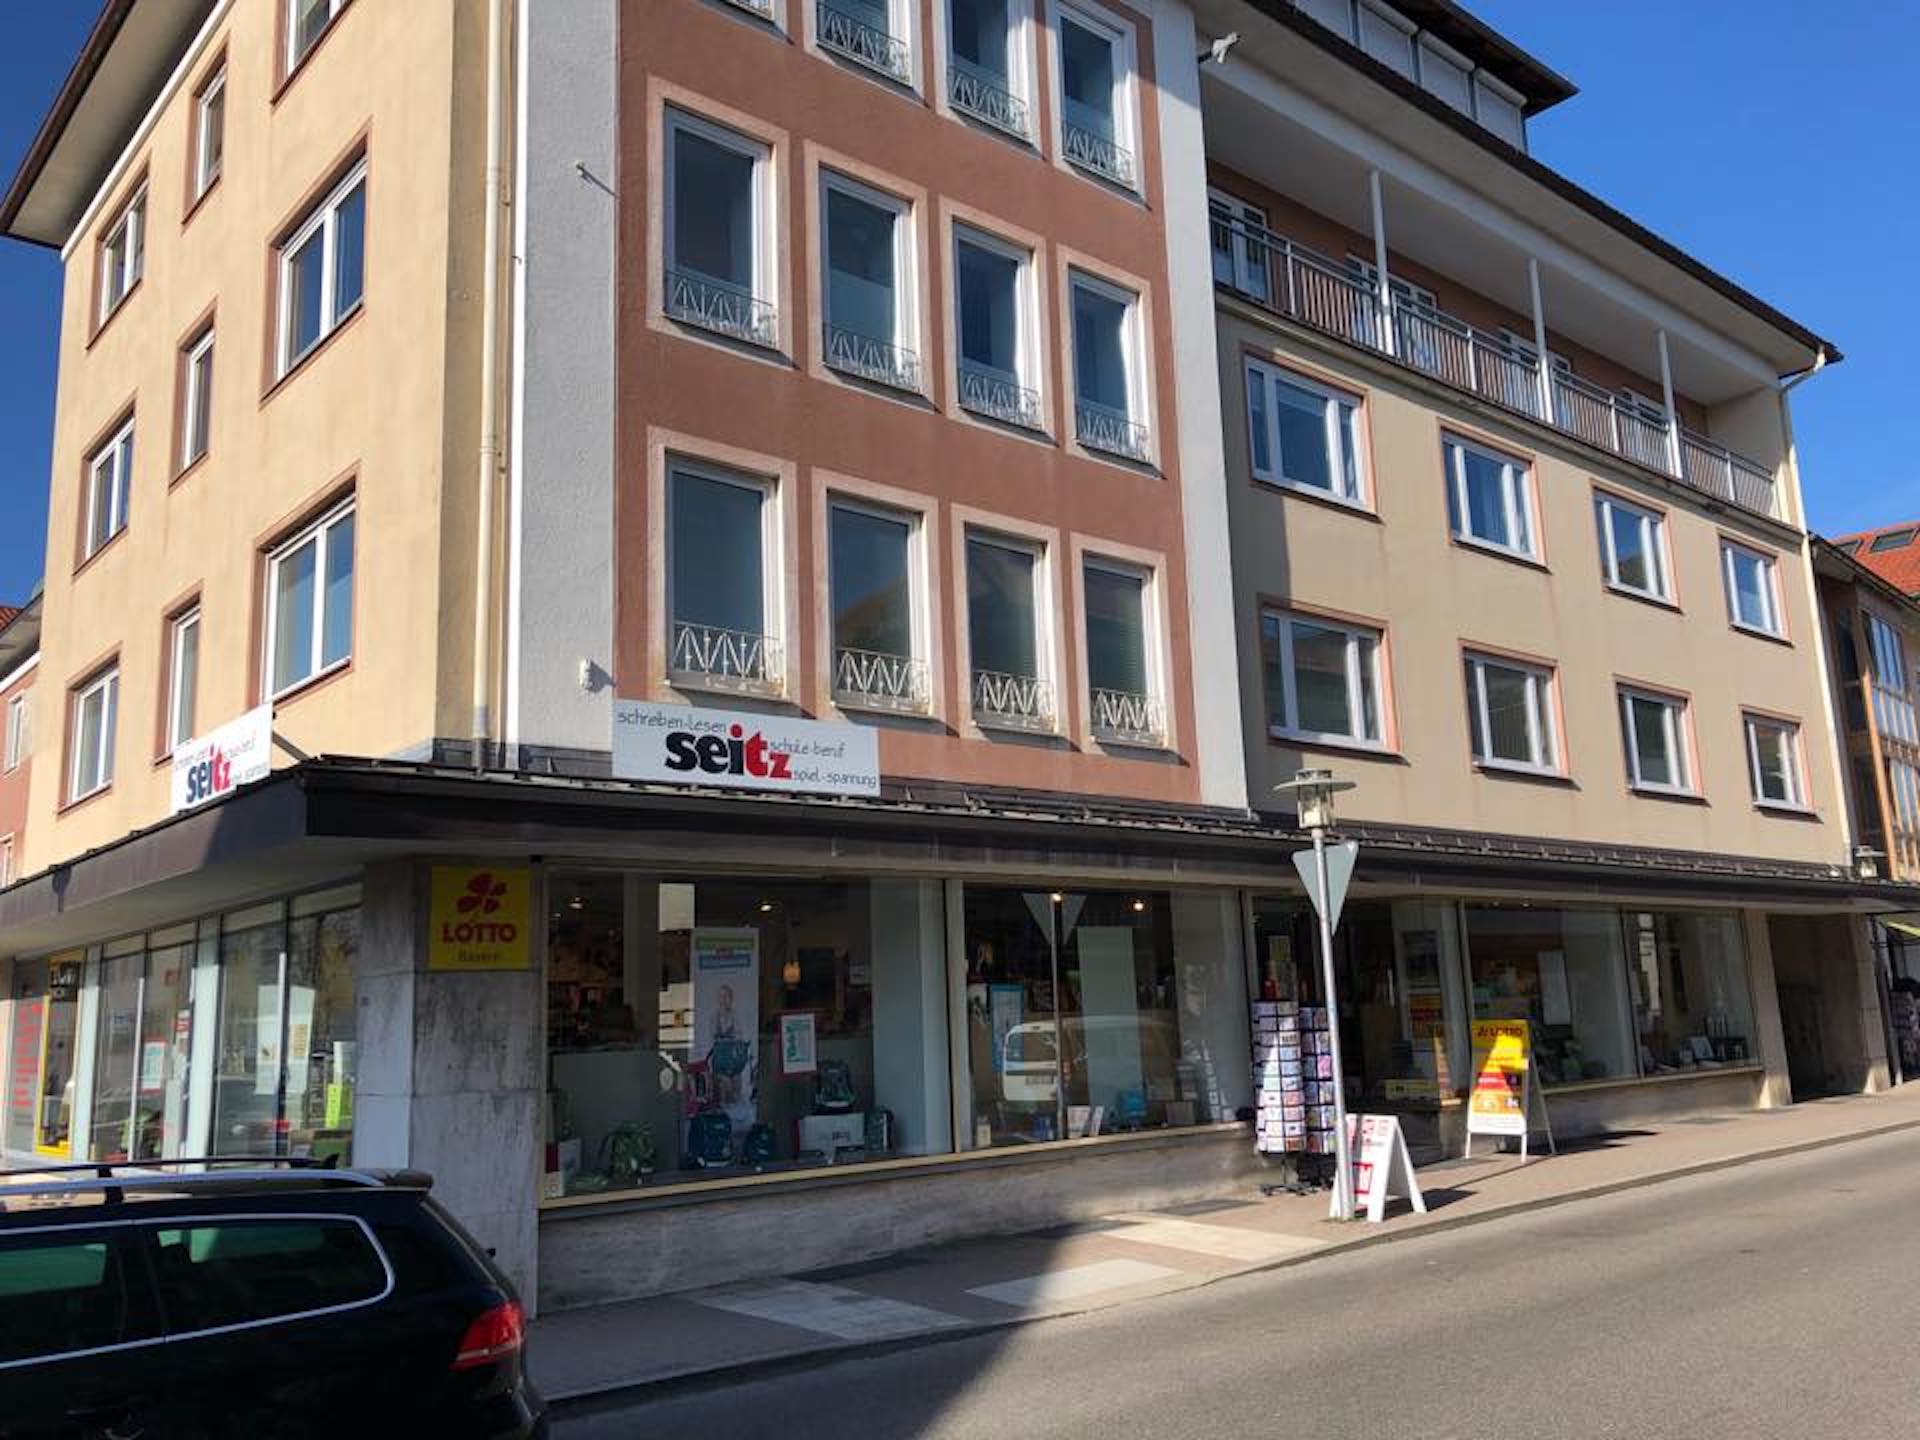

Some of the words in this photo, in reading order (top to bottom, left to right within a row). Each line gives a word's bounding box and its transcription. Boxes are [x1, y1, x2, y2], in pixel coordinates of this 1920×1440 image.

[186, 742, 231, 804] seitz
[664, 723, 793, 780] seitz
[442, 921, 517, 943] LOTTO
